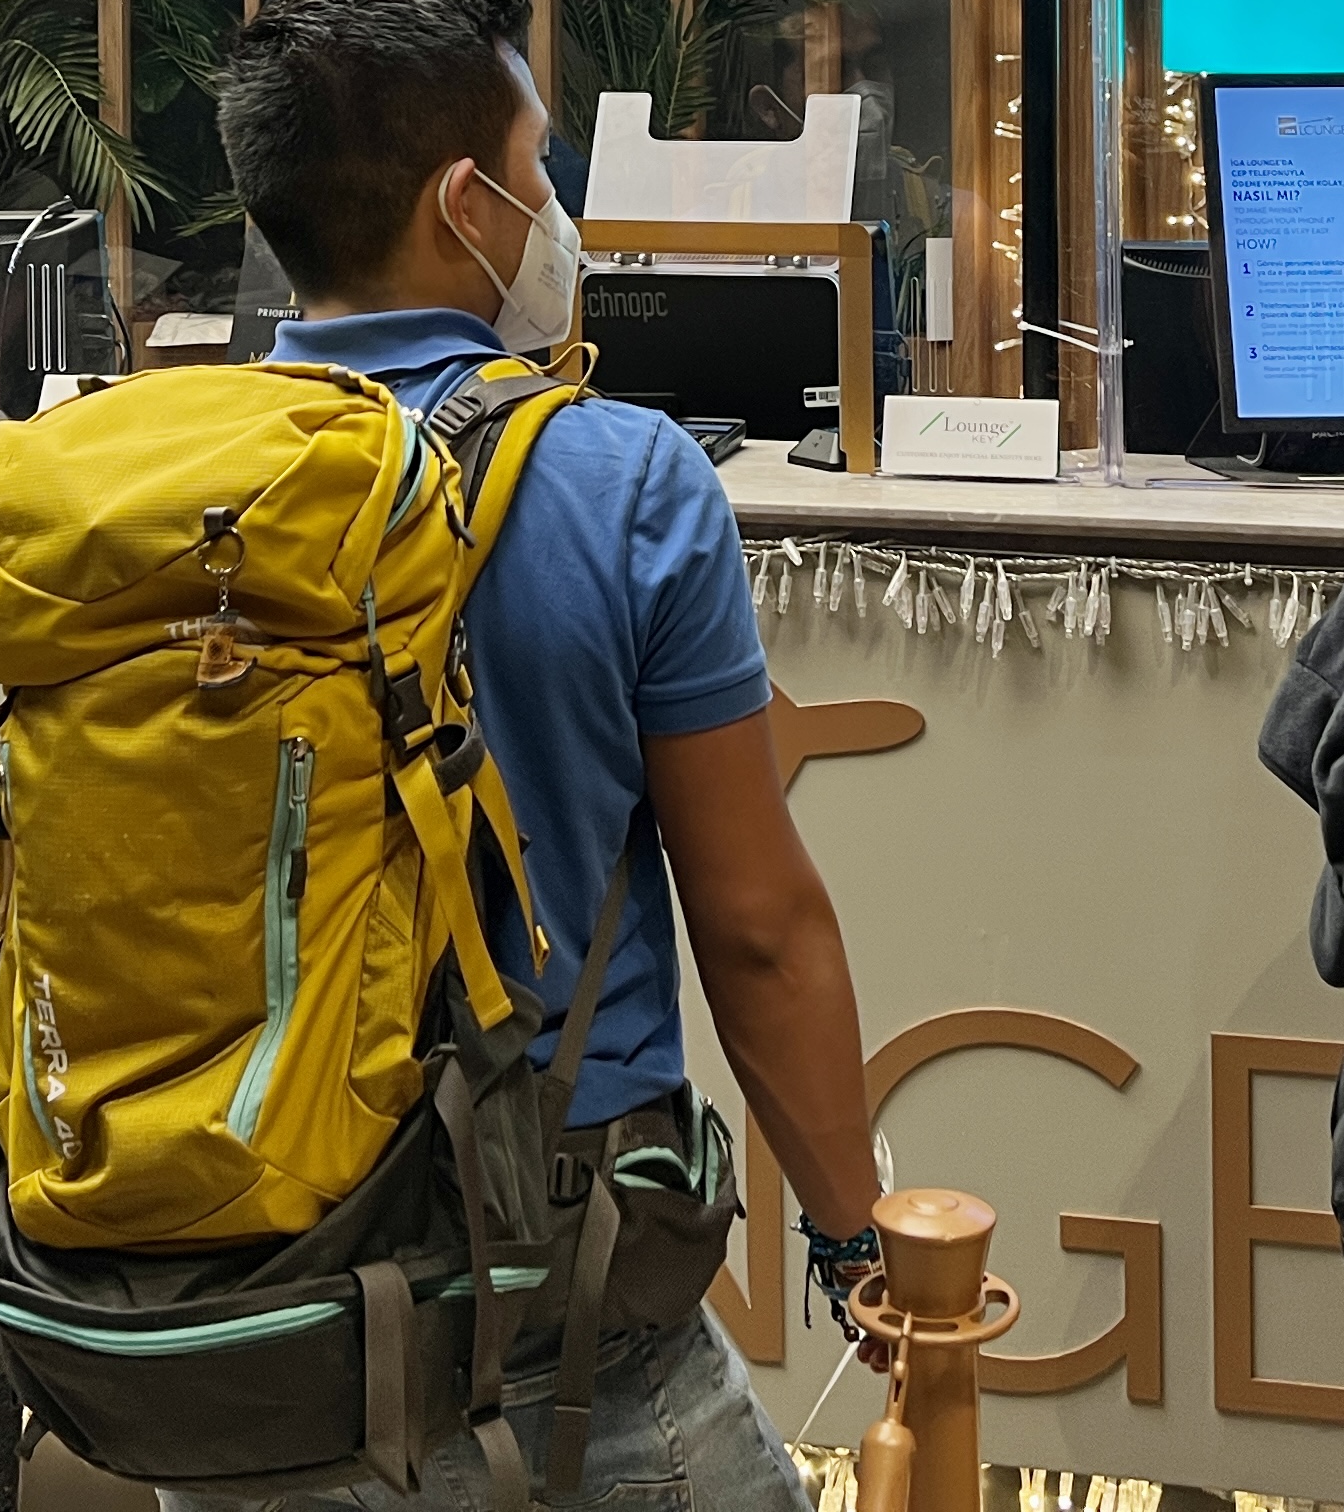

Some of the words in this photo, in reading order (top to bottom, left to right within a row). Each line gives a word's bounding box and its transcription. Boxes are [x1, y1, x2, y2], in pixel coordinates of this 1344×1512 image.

[1233, 190, 1274, 201] NASIL
[1277, 190, 1300, 201] MI?
[1236, 238, 1277, 249] HOW?
[1243, 263, 1251, 275] 1
[582, 285, 668, 323] chnopc
[257, 308, 301, 319] PRIORITY
[1245, 305, 1254, 317] 2
[1249, 347, 1258, 359] 3
[944, 416, 1010, 437] Lounge
[971, 434, 995, 444] KEY
[33, 973, 69, 1103] TERRA
